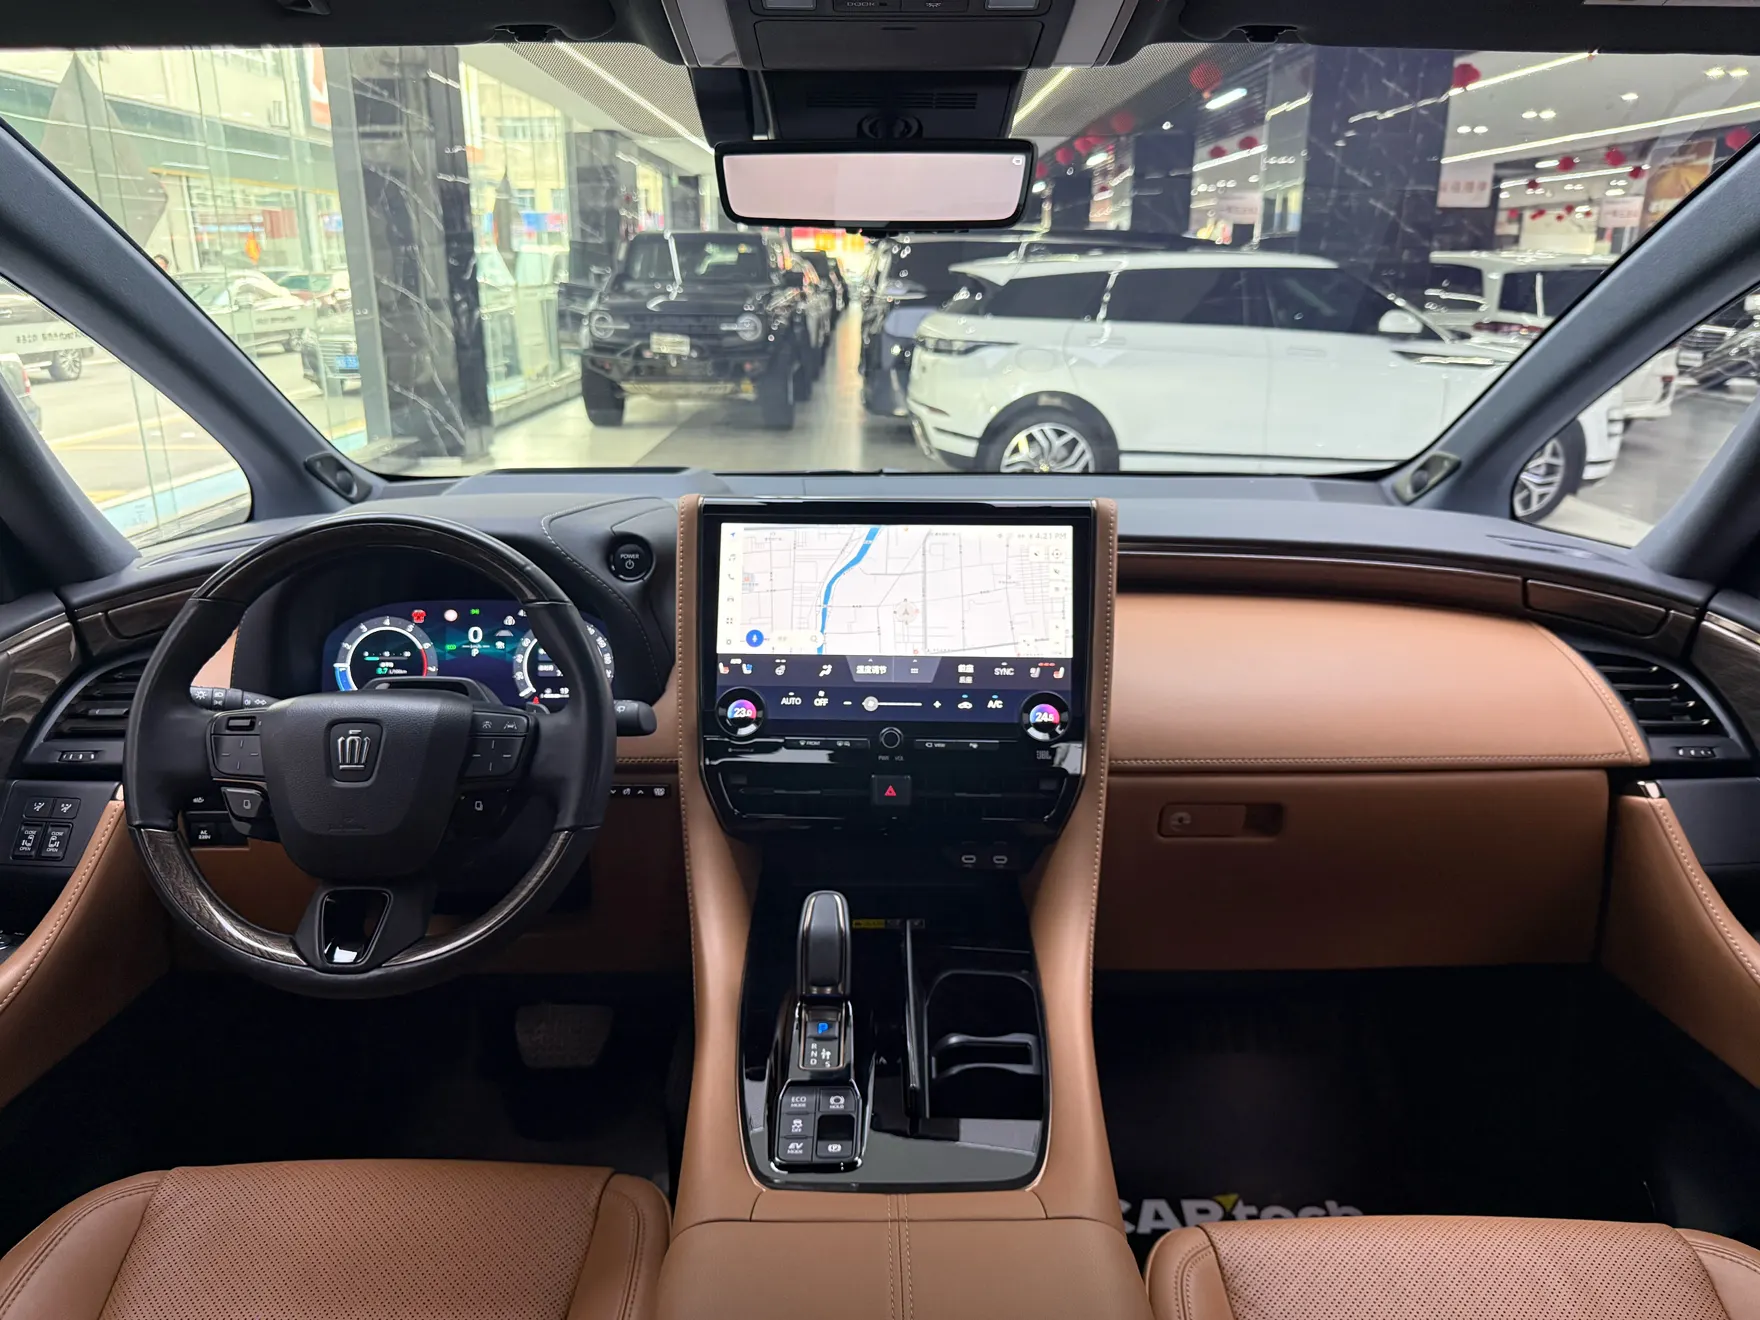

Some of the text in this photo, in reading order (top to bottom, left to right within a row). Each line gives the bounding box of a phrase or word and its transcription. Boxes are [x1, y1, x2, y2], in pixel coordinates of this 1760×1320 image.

[1054, 532, 1067, 540] PM
[467, 626, 483, 643] 0
[994, 667, 1015, 676] SYNC
[781, 697, 802, 705] AUTO
[814, 698, 829, 707] OFF
[987, 700, 1003, 709] A/C
[734, 707, 752, 718] 23.0
[817, 1022, 829, 1034] P
[810, 1050, 818, 1058] N
[810, 1058, 817, 1066] D
